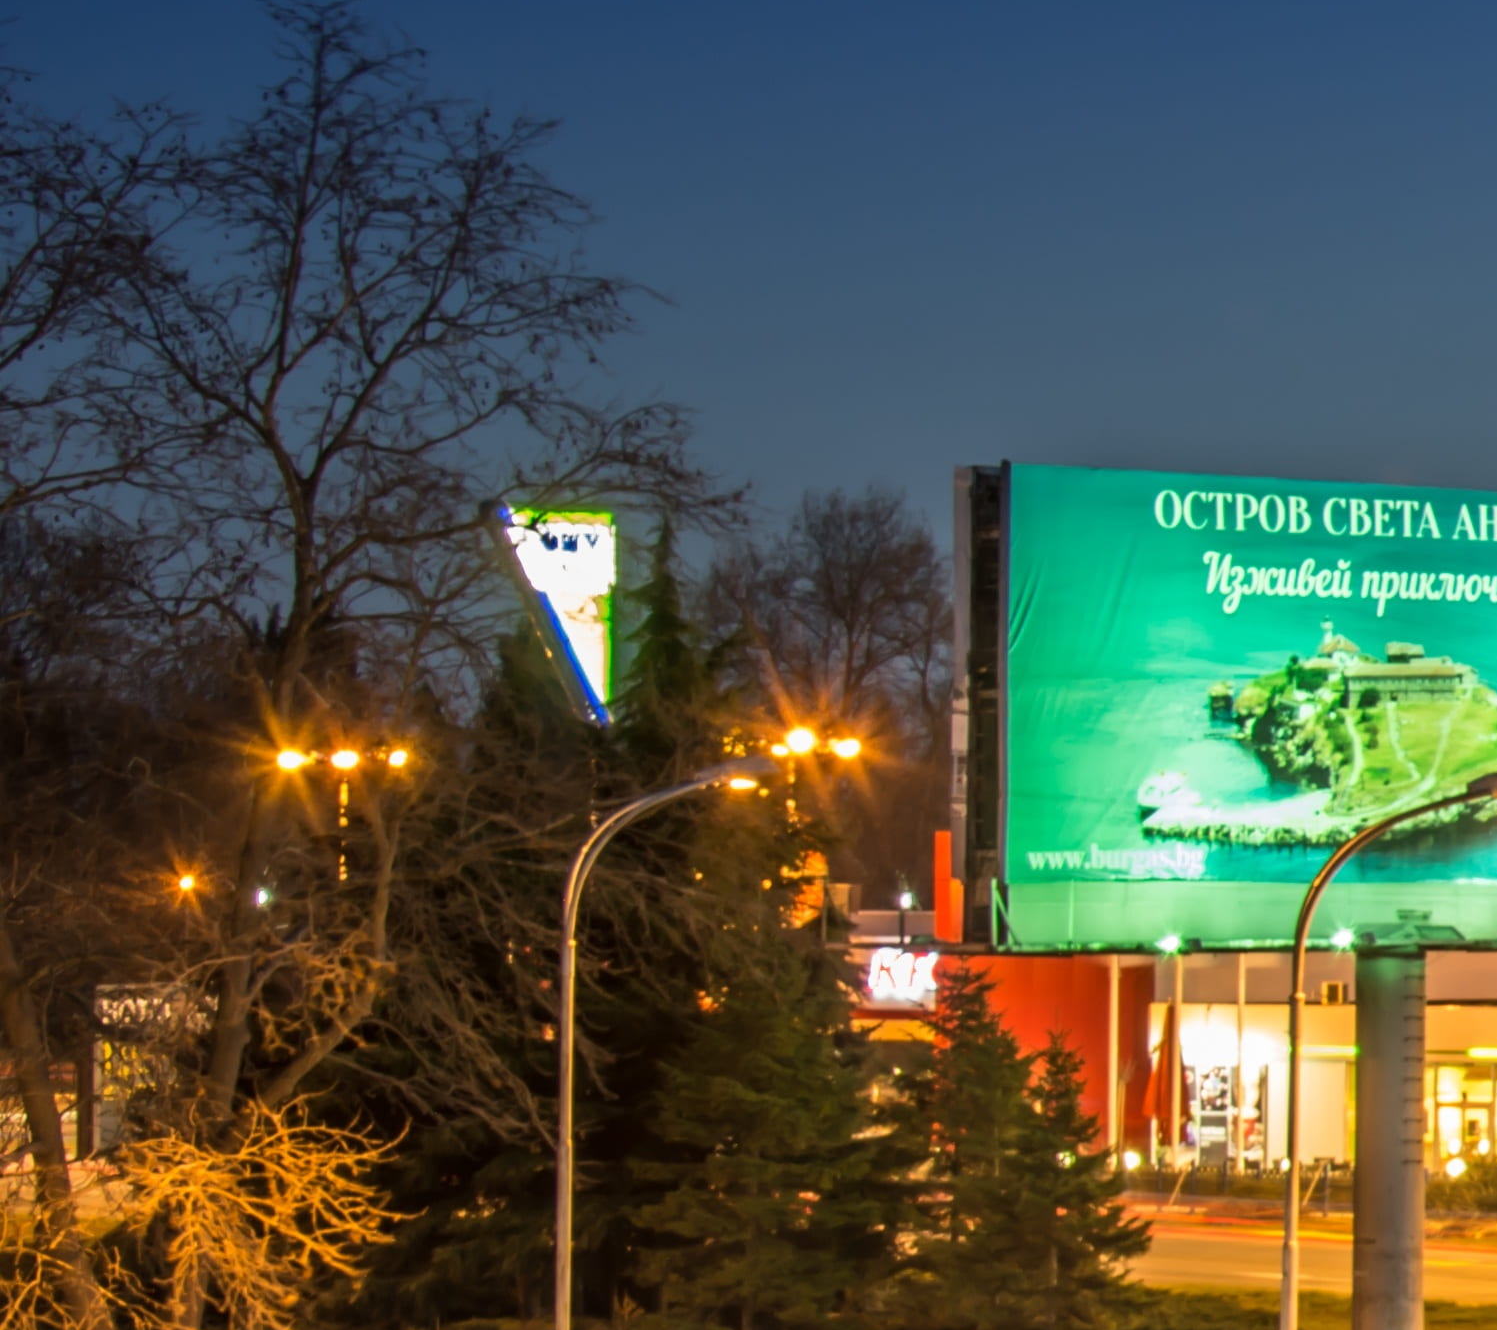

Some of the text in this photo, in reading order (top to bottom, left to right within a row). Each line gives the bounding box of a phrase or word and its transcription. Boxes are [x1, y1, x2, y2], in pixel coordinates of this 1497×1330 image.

[1153, 489, 1312, 534] ОСТРОВ
[1322, 497, 1443, 540] СВЕТА
[1202, 550, 1353, 615] Изживей
[1026, 842, 1207, 880] www.burgas.bg
